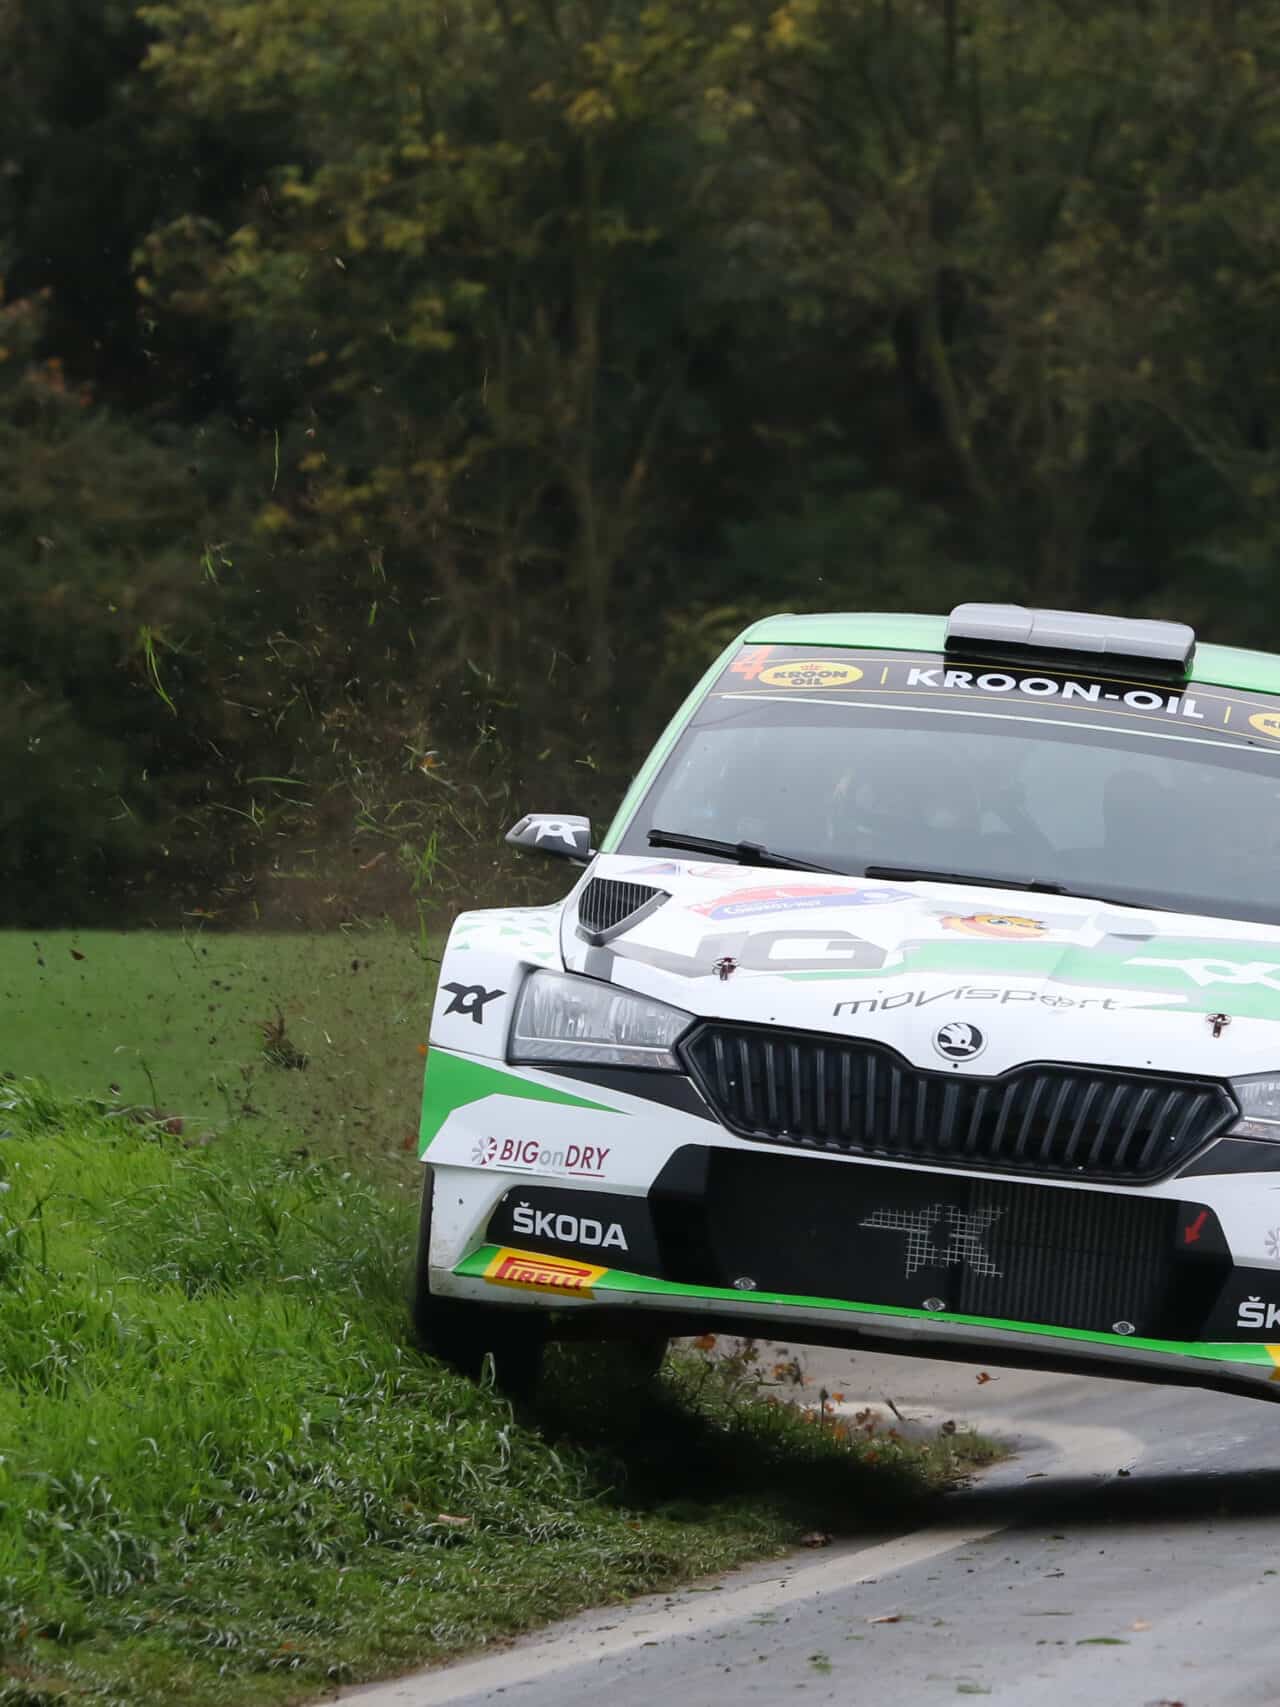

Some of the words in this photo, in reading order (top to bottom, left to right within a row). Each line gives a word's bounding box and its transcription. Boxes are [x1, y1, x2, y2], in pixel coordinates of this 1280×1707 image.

[772, 670, 849, 679] KROON
[790, 678, 824, 686] OIL
[907, 667, 1204, 719] KROON-OIL
[500, 1138, 611, 1170] BIGonDRY
[512, 1201, 629, 1251] ŠKODA
[494, 1255, 593, 1291] PIRELLI
